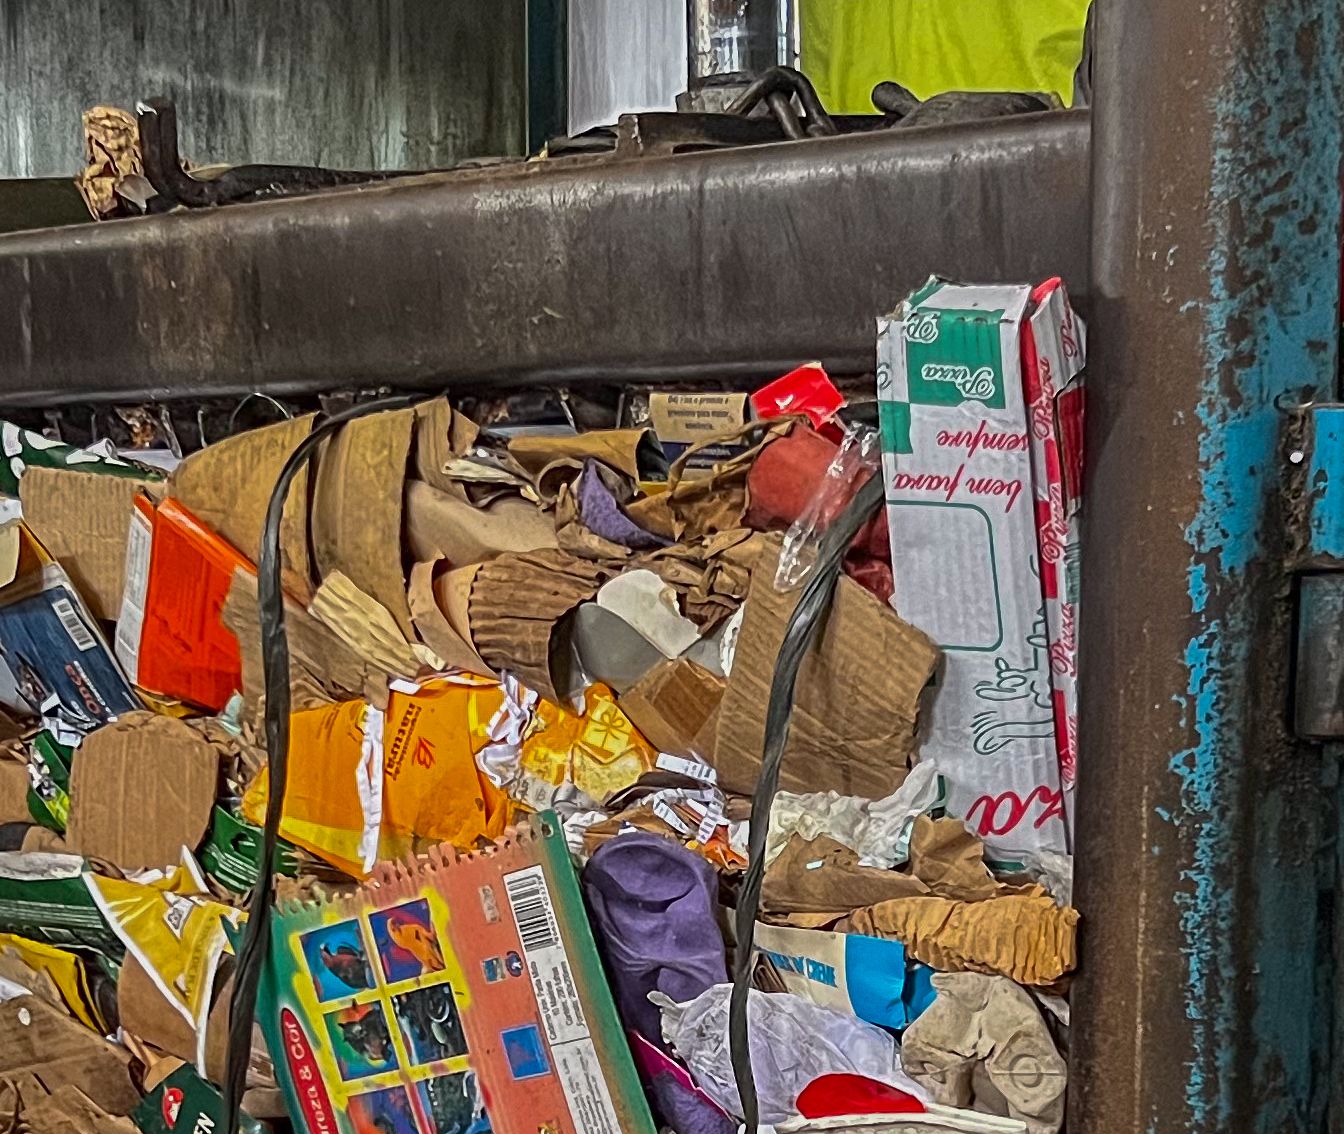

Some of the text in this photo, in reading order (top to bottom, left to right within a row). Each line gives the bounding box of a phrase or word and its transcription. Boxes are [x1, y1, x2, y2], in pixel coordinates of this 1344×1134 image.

[923, 365, 994, 398] Pizza
[892, 464, 1023, 513] bem para
[285, 1021, 305, 1060] Cor
[299, 1065, 313, 1080] &
